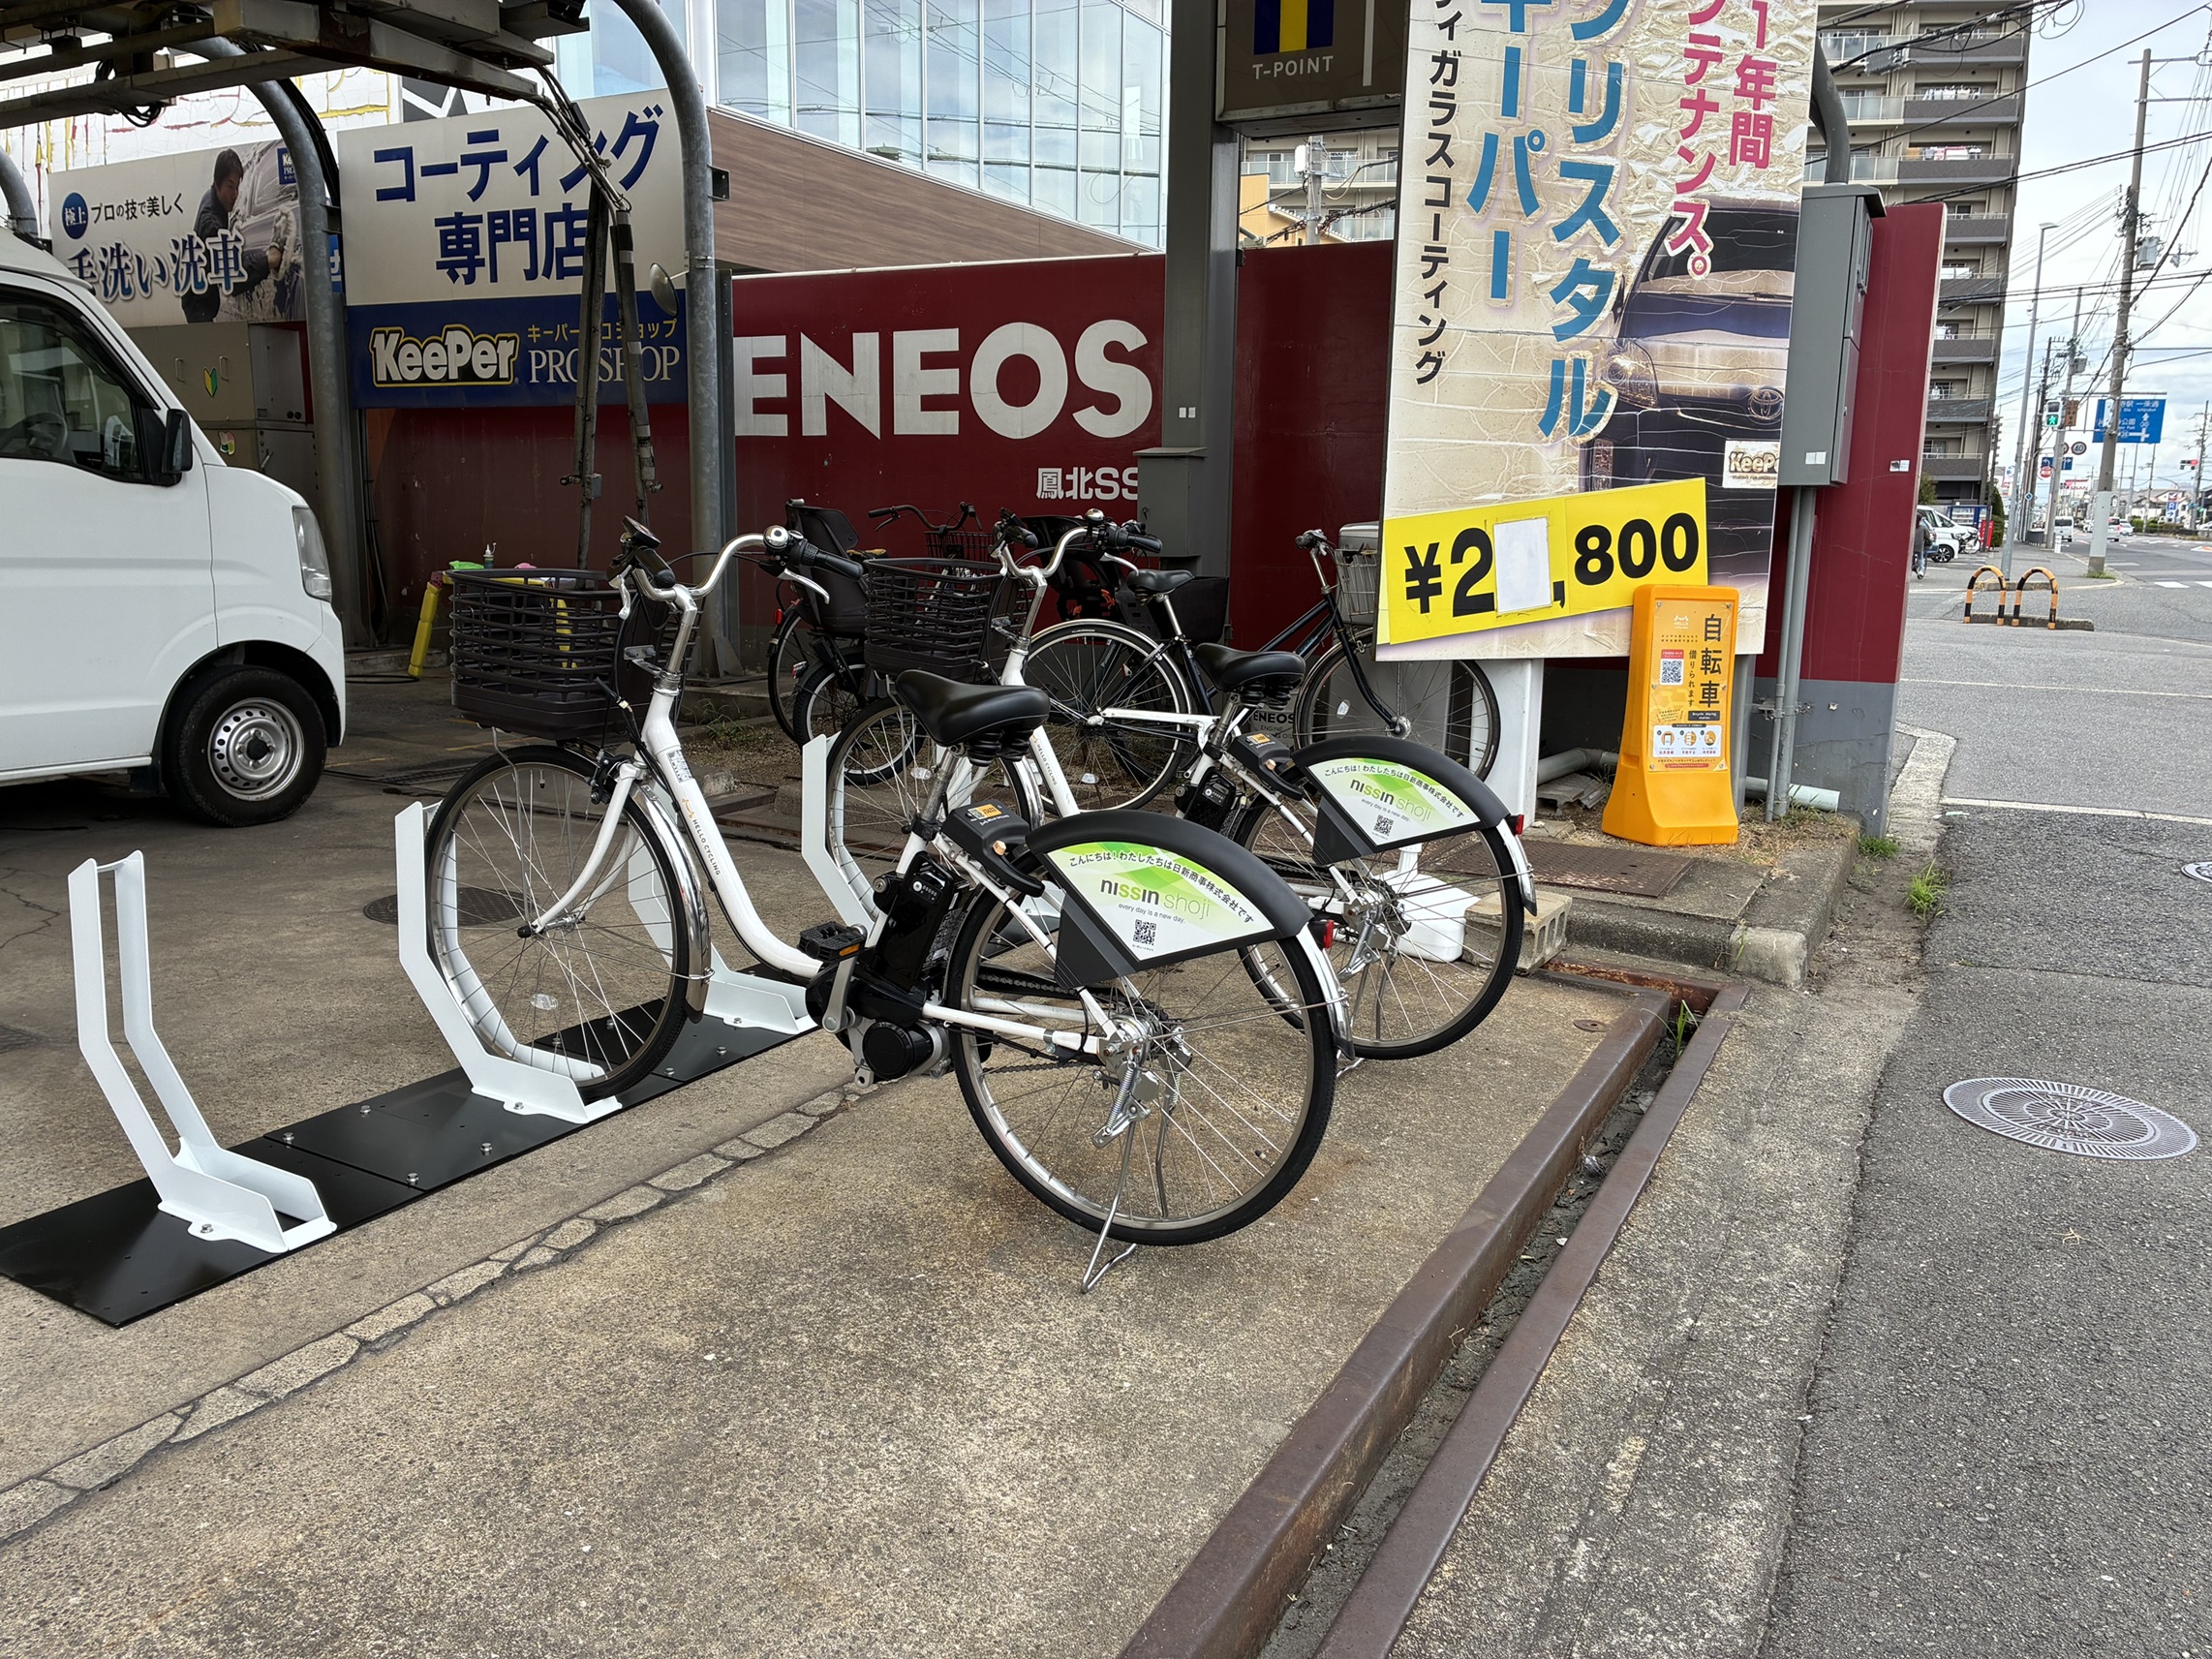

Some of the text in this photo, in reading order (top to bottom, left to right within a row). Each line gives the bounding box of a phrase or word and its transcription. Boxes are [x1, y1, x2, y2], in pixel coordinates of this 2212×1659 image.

[1252, 55, 1334, 79] T-POINT
[374, 104, 663, 202] コーティング
[64, 205, 87, 227] 極上
[91, 193, 184, 224] プロの技で美しく
[67, 230, 247, 299] 手洗い洗車
[434, 202, 590, 285] 専門店
[371, 325, 518, 384] KeePer
[733, 320, 1152, 440] ENEOS
[2074, 444, 2084, 452] 40
[1036, 467, 1138, 501] 鳳北SS
[1688, 650, 1698, 707] 借りられます
[1699, 613, 1723, 708] 自転車
[1253, 712, 1294, 723] ENEOS
[1350, 778, 1431, 821] nissin shoji
[692, 818, 721, 876] HELLO CYCLING
[1100, 879, 1211, 921] nissin shoji
[1118, 903, 1134, 912] every
[1135, 906, 1147, 916] day
[1173, 915, 1185, 924] day.
